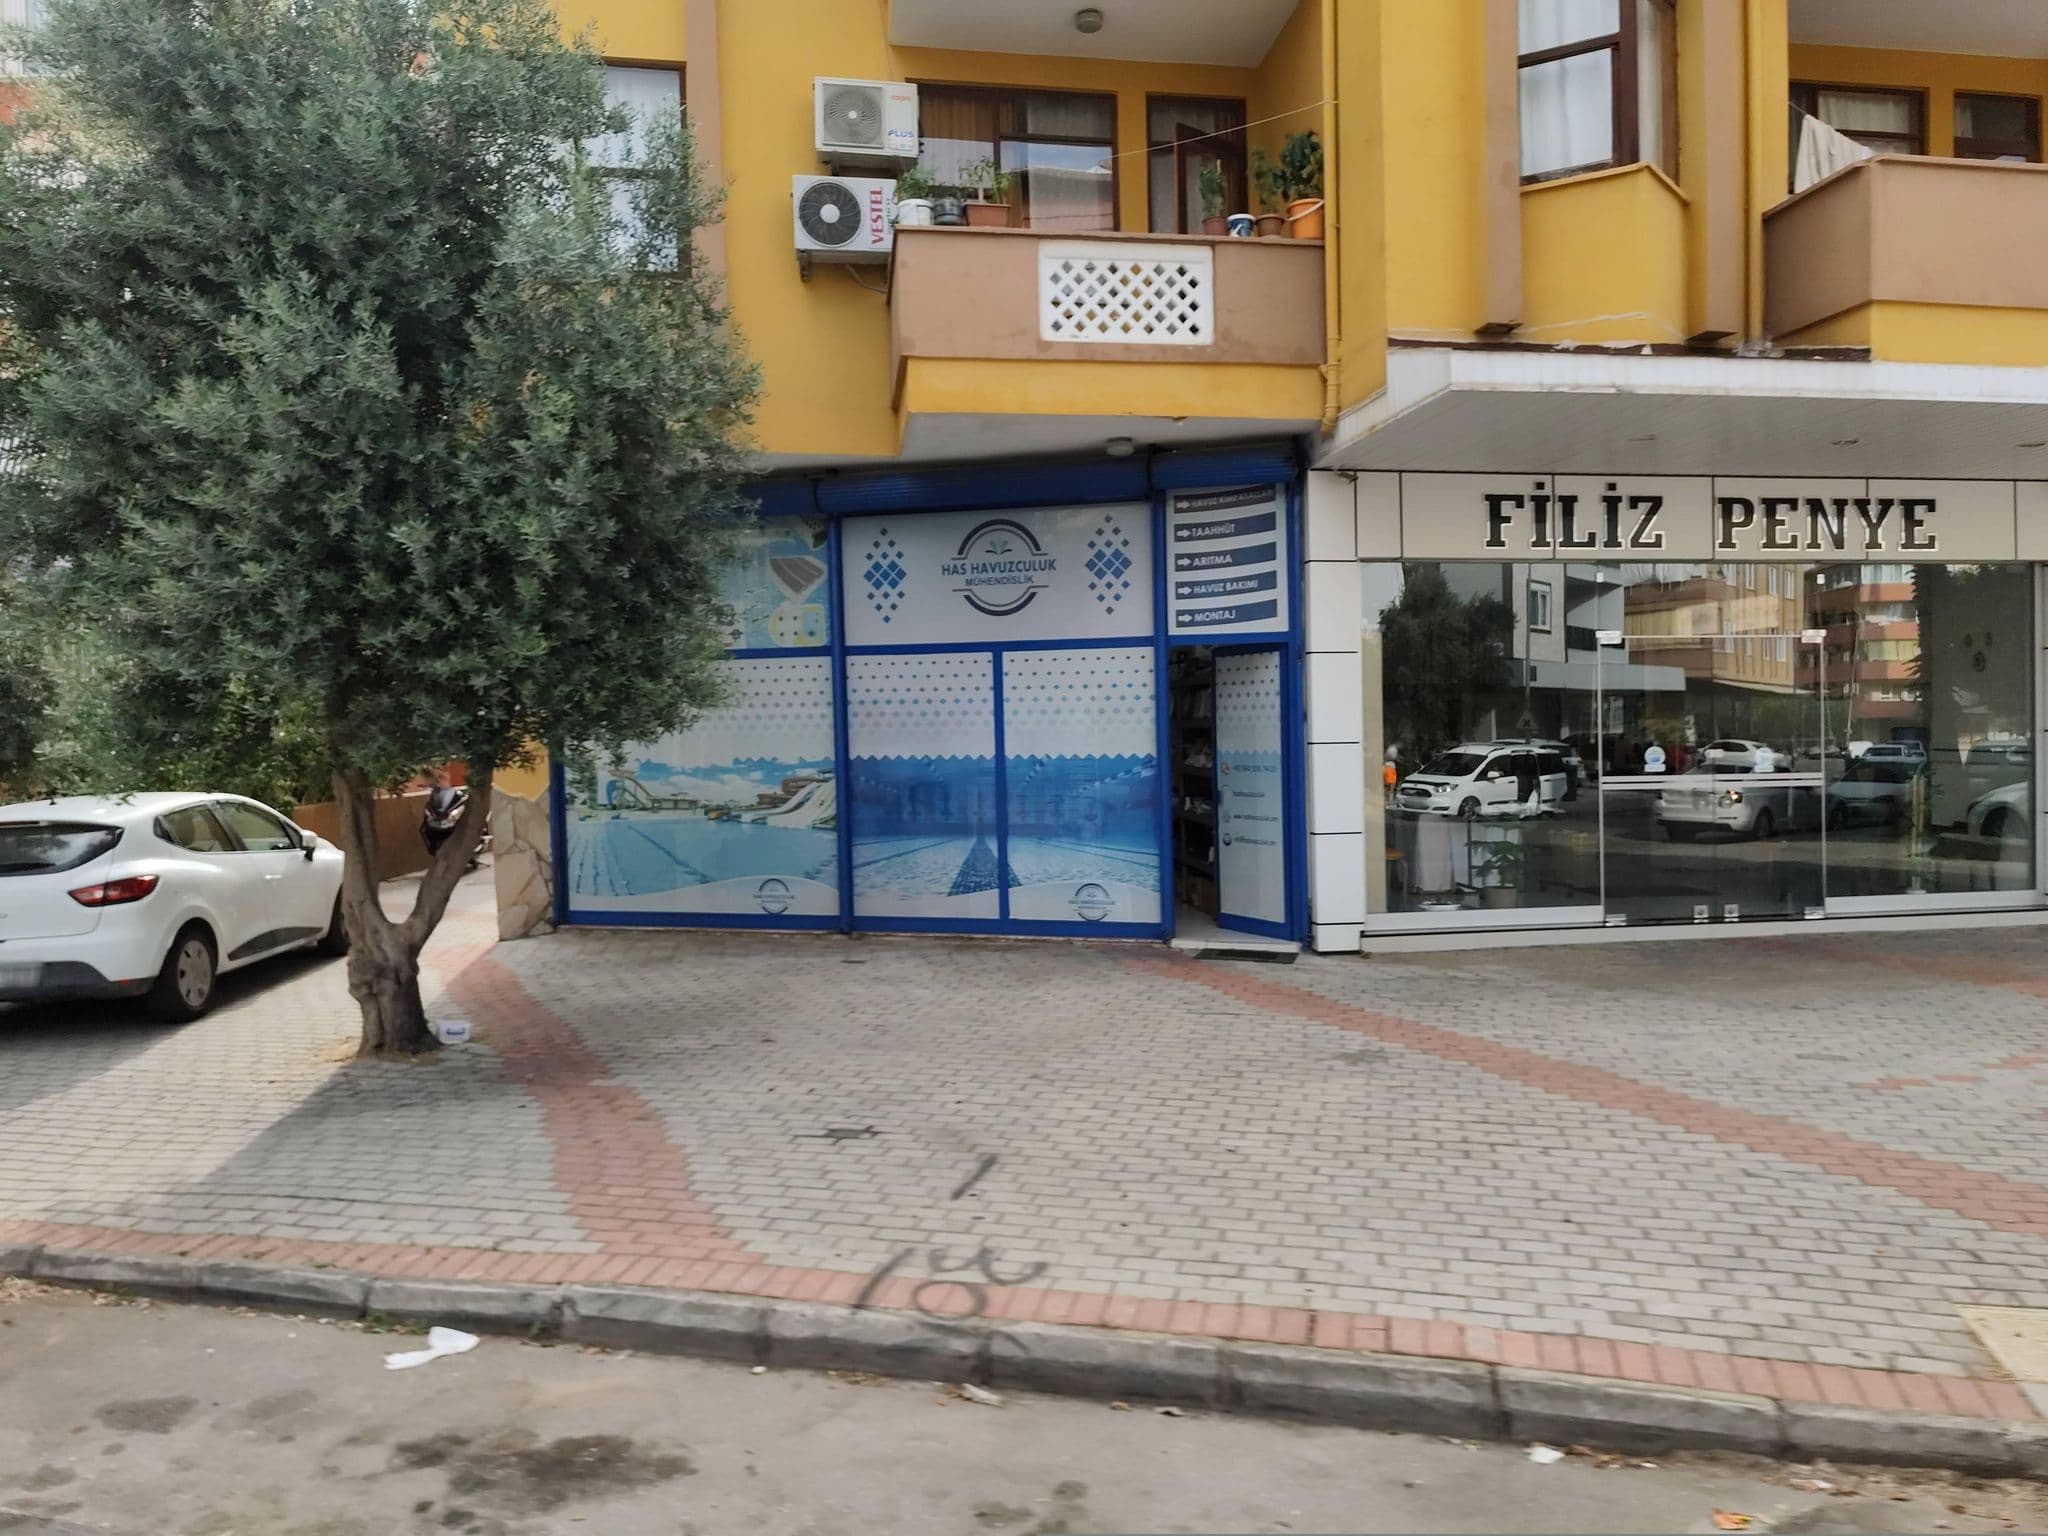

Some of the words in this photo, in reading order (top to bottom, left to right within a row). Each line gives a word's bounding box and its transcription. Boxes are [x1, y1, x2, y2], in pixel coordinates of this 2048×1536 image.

[888, 129, 914, 138] PLUS
[870, 186, 884, 245] VESTEL
[1484, 481, 1665, 550] FİLİZ
[1716, 496, 1937, 551] PENYE
[1191, 523, 1236, 537] TAAHHÜT
[942, 563, 967, 576] HAS
[971, 559, 1057, 575] HAVUZCULUK
[1192, 554, 1232, 567] ARITMA
[965, 574, 1035, 587] MÜHENDİSLİK
[1193, 584, 1224, 594] HAVUZ
[1225, 579, 1258, 591] BAKIMI
[1194, 609, 1236, 622] MONTAJ
